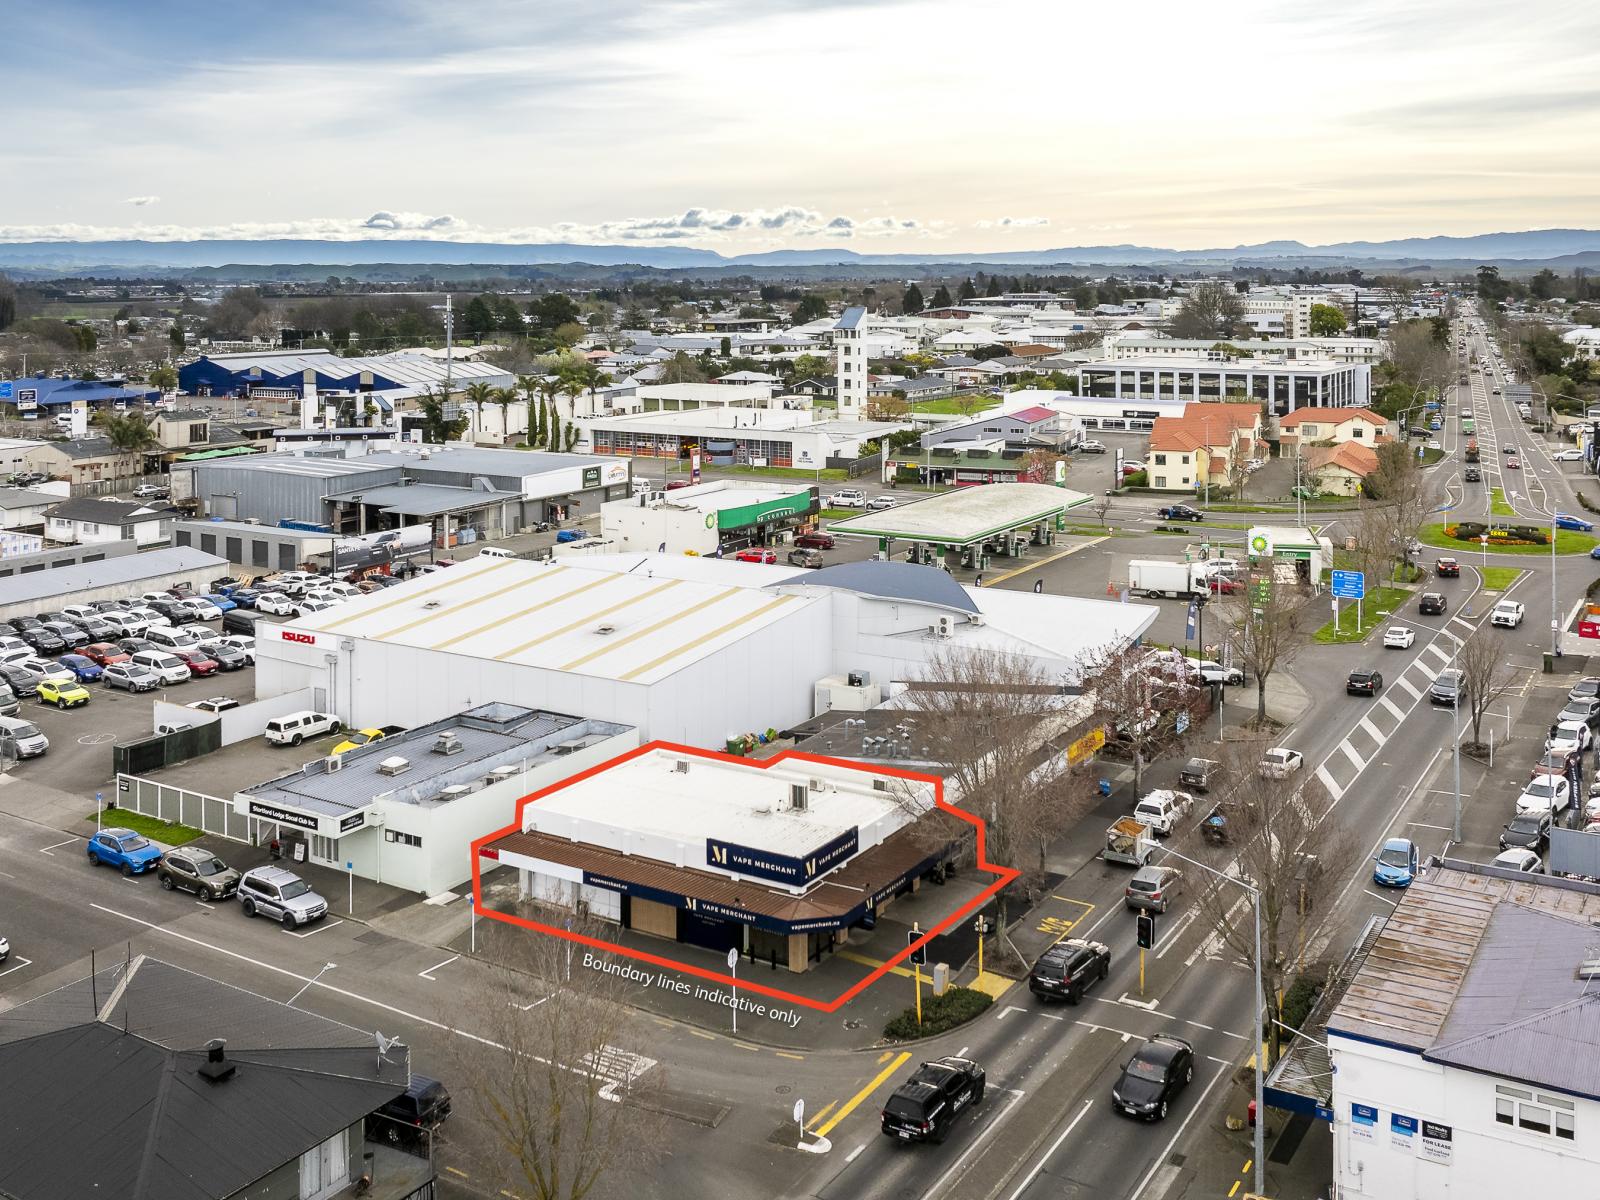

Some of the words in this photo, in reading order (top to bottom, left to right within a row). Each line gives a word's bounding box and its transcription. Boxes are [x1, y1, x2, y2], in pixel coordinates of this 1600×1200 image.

[282, 631, 316, 644] ISUZU
[272, 810, 285, 820] Lodge
[285, 814, 298, 822] Social
[818, 854, 831, 866] VAPE
[832, 838, 856, 858] MERCHANT
[732, 855, 752, 866] VAPE
[754, 860, 796, 876] MERCHANT
[702, 903, 719, 914] VAPE
[720, 907, 756, 922] MERCHANT
[791, 920, 840, 930] vapemerchant.nz
[1434, 1142, 1452, 1150] LEASE
